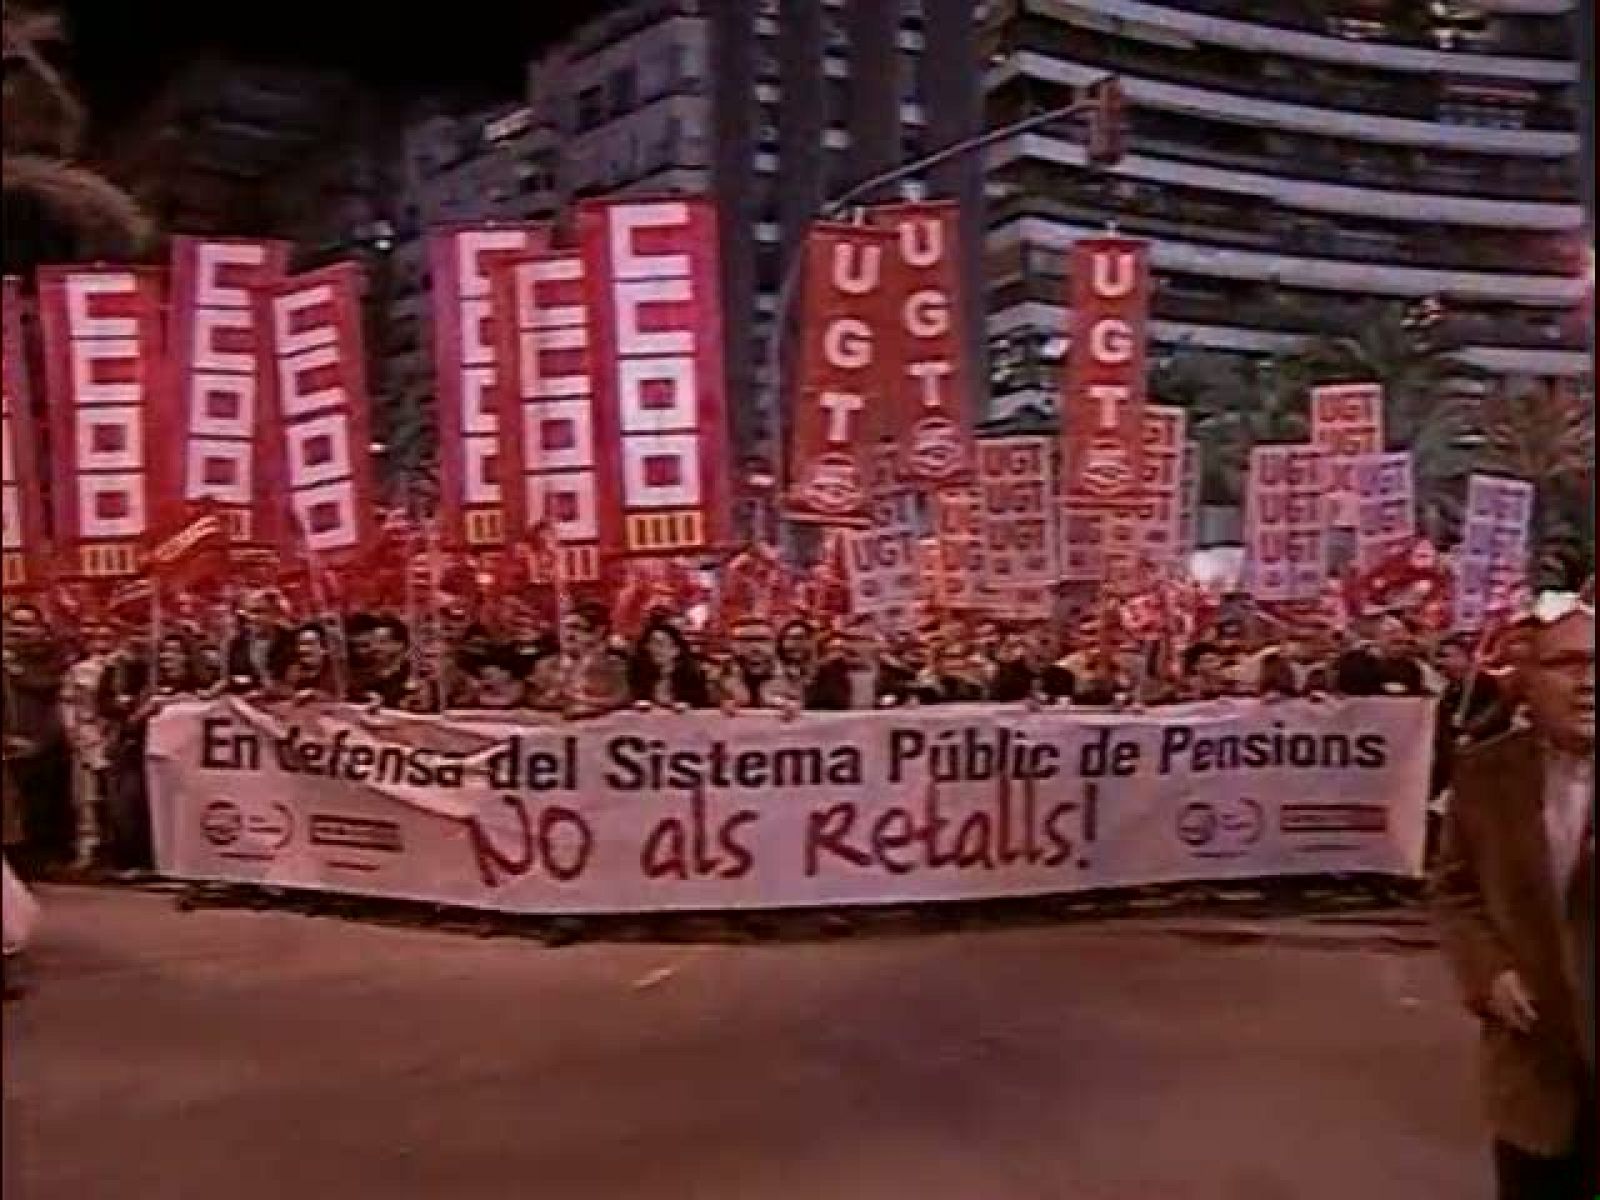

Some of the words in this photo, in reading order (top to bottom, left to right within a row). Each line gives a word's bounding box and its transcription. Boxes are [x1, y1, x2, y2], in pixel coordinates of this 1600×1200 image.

[819, 242, 882, 442] UGT
[898, 217, 955, 407] UGT
[1088, 252, 1135, 429] UGT
[985, 443, 1042, 476] UGT
[1259, 453, 1321, 485] UGT
[1259, 491, 1321, 525] UGT
[201, 715, 259, 770] En
[488, 735, 577, 791] del
[603, 735, 862, 791] Sistema
[886, 726, 1061, 784] Públic
[1079, 726, 1142, 777] de
[1158, 720, 1387, 776] Pensions
[642, 777, 760, 881] als
